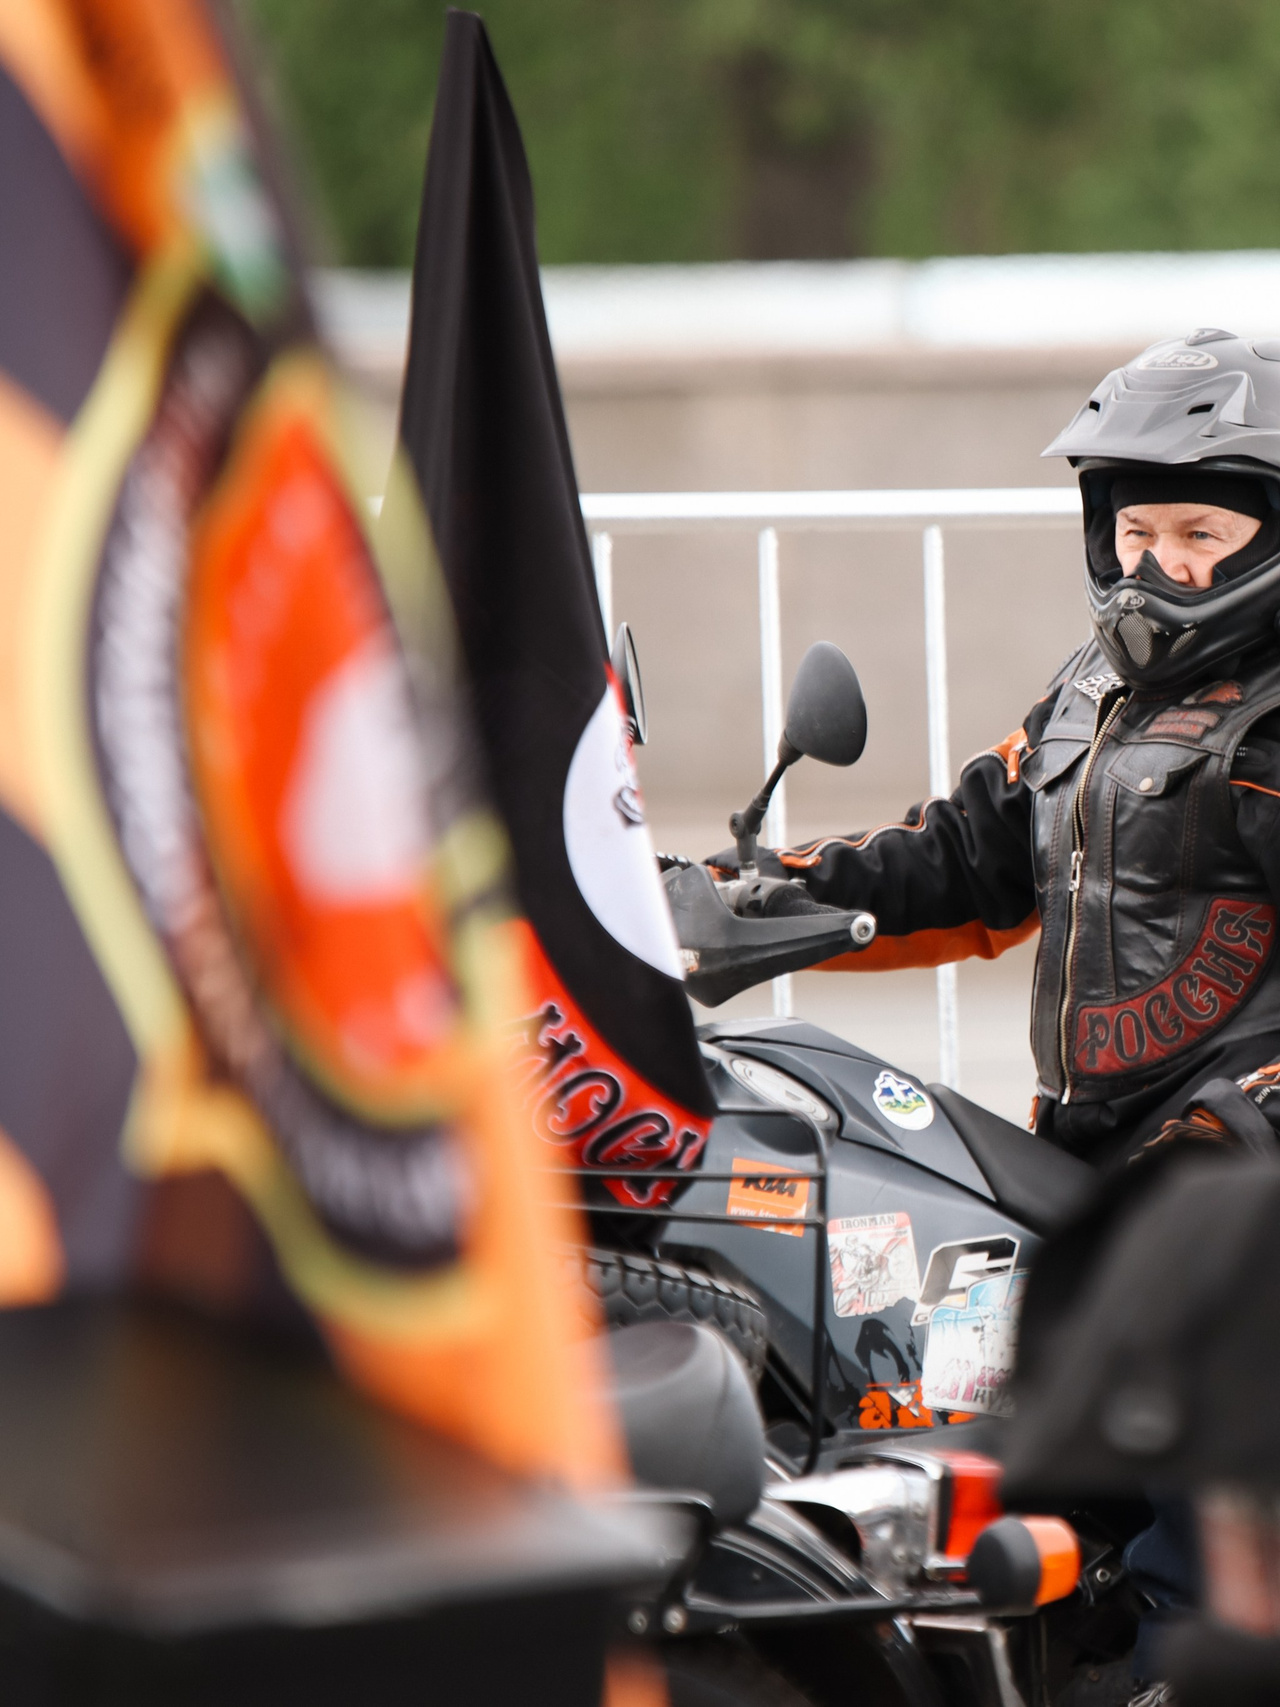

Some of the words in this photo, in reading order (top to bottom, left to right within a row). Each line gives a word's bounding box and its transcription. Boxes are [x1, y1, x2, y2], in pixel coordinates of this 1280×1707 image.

[1074, 904, 1272, 1069] РОССИЯ
[1254, 1086, 1271, 1105] SKIN
[840, 1214, 896, 1229] IRONMAN
